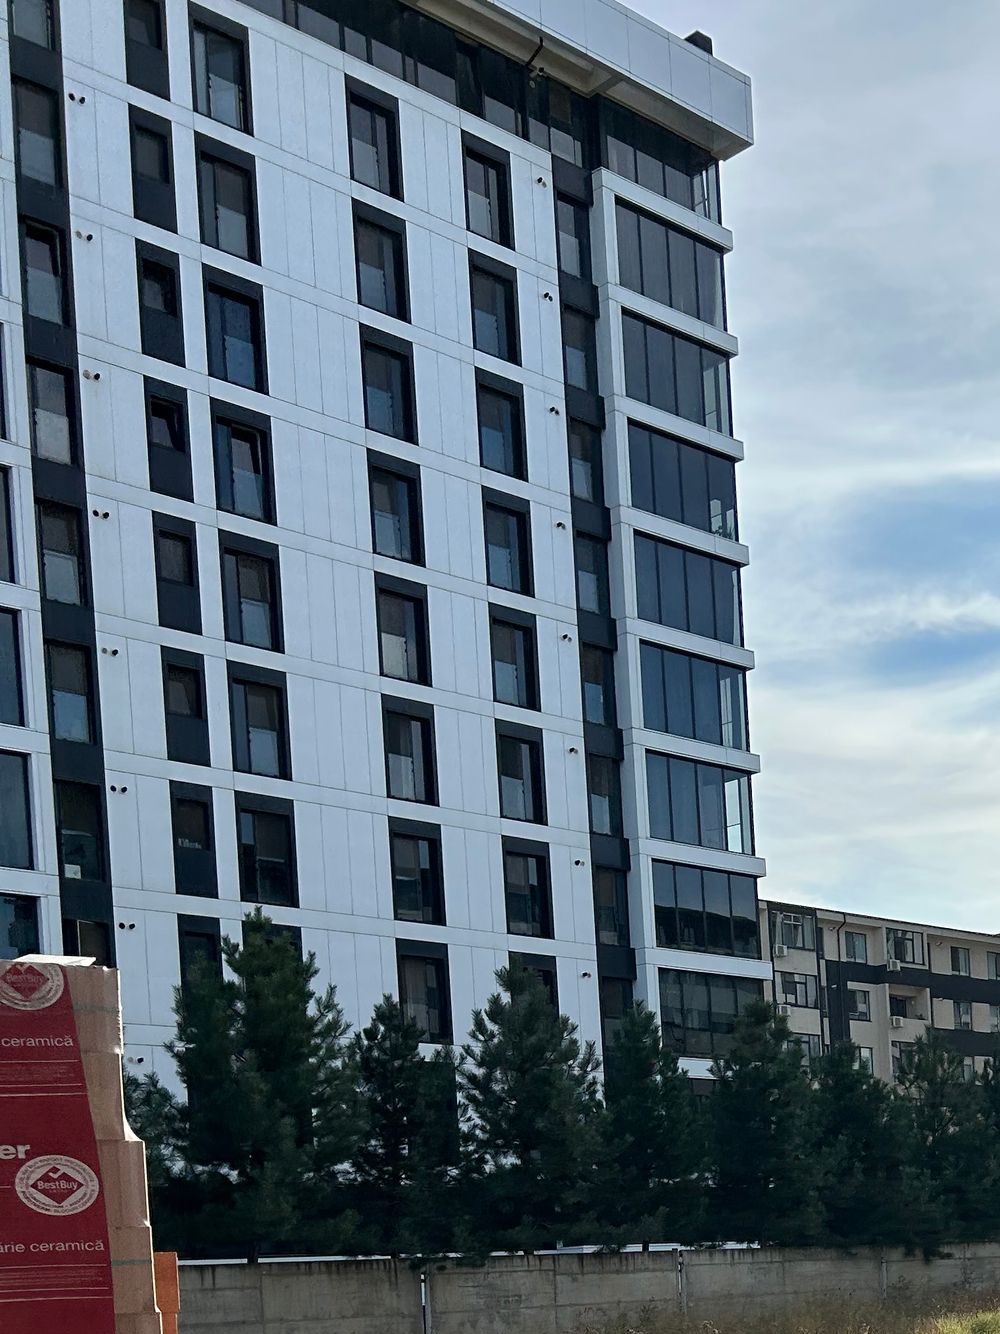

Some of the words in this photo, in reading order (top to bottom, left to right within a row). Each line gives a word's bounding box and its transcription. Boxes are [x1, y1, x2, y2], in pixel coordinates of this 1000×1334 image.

[1, 1034, 73, 1047] ceramică
[37, 1180, 78, 1190] BestBuy
[30, 1239, 105, 1252] ceramică
